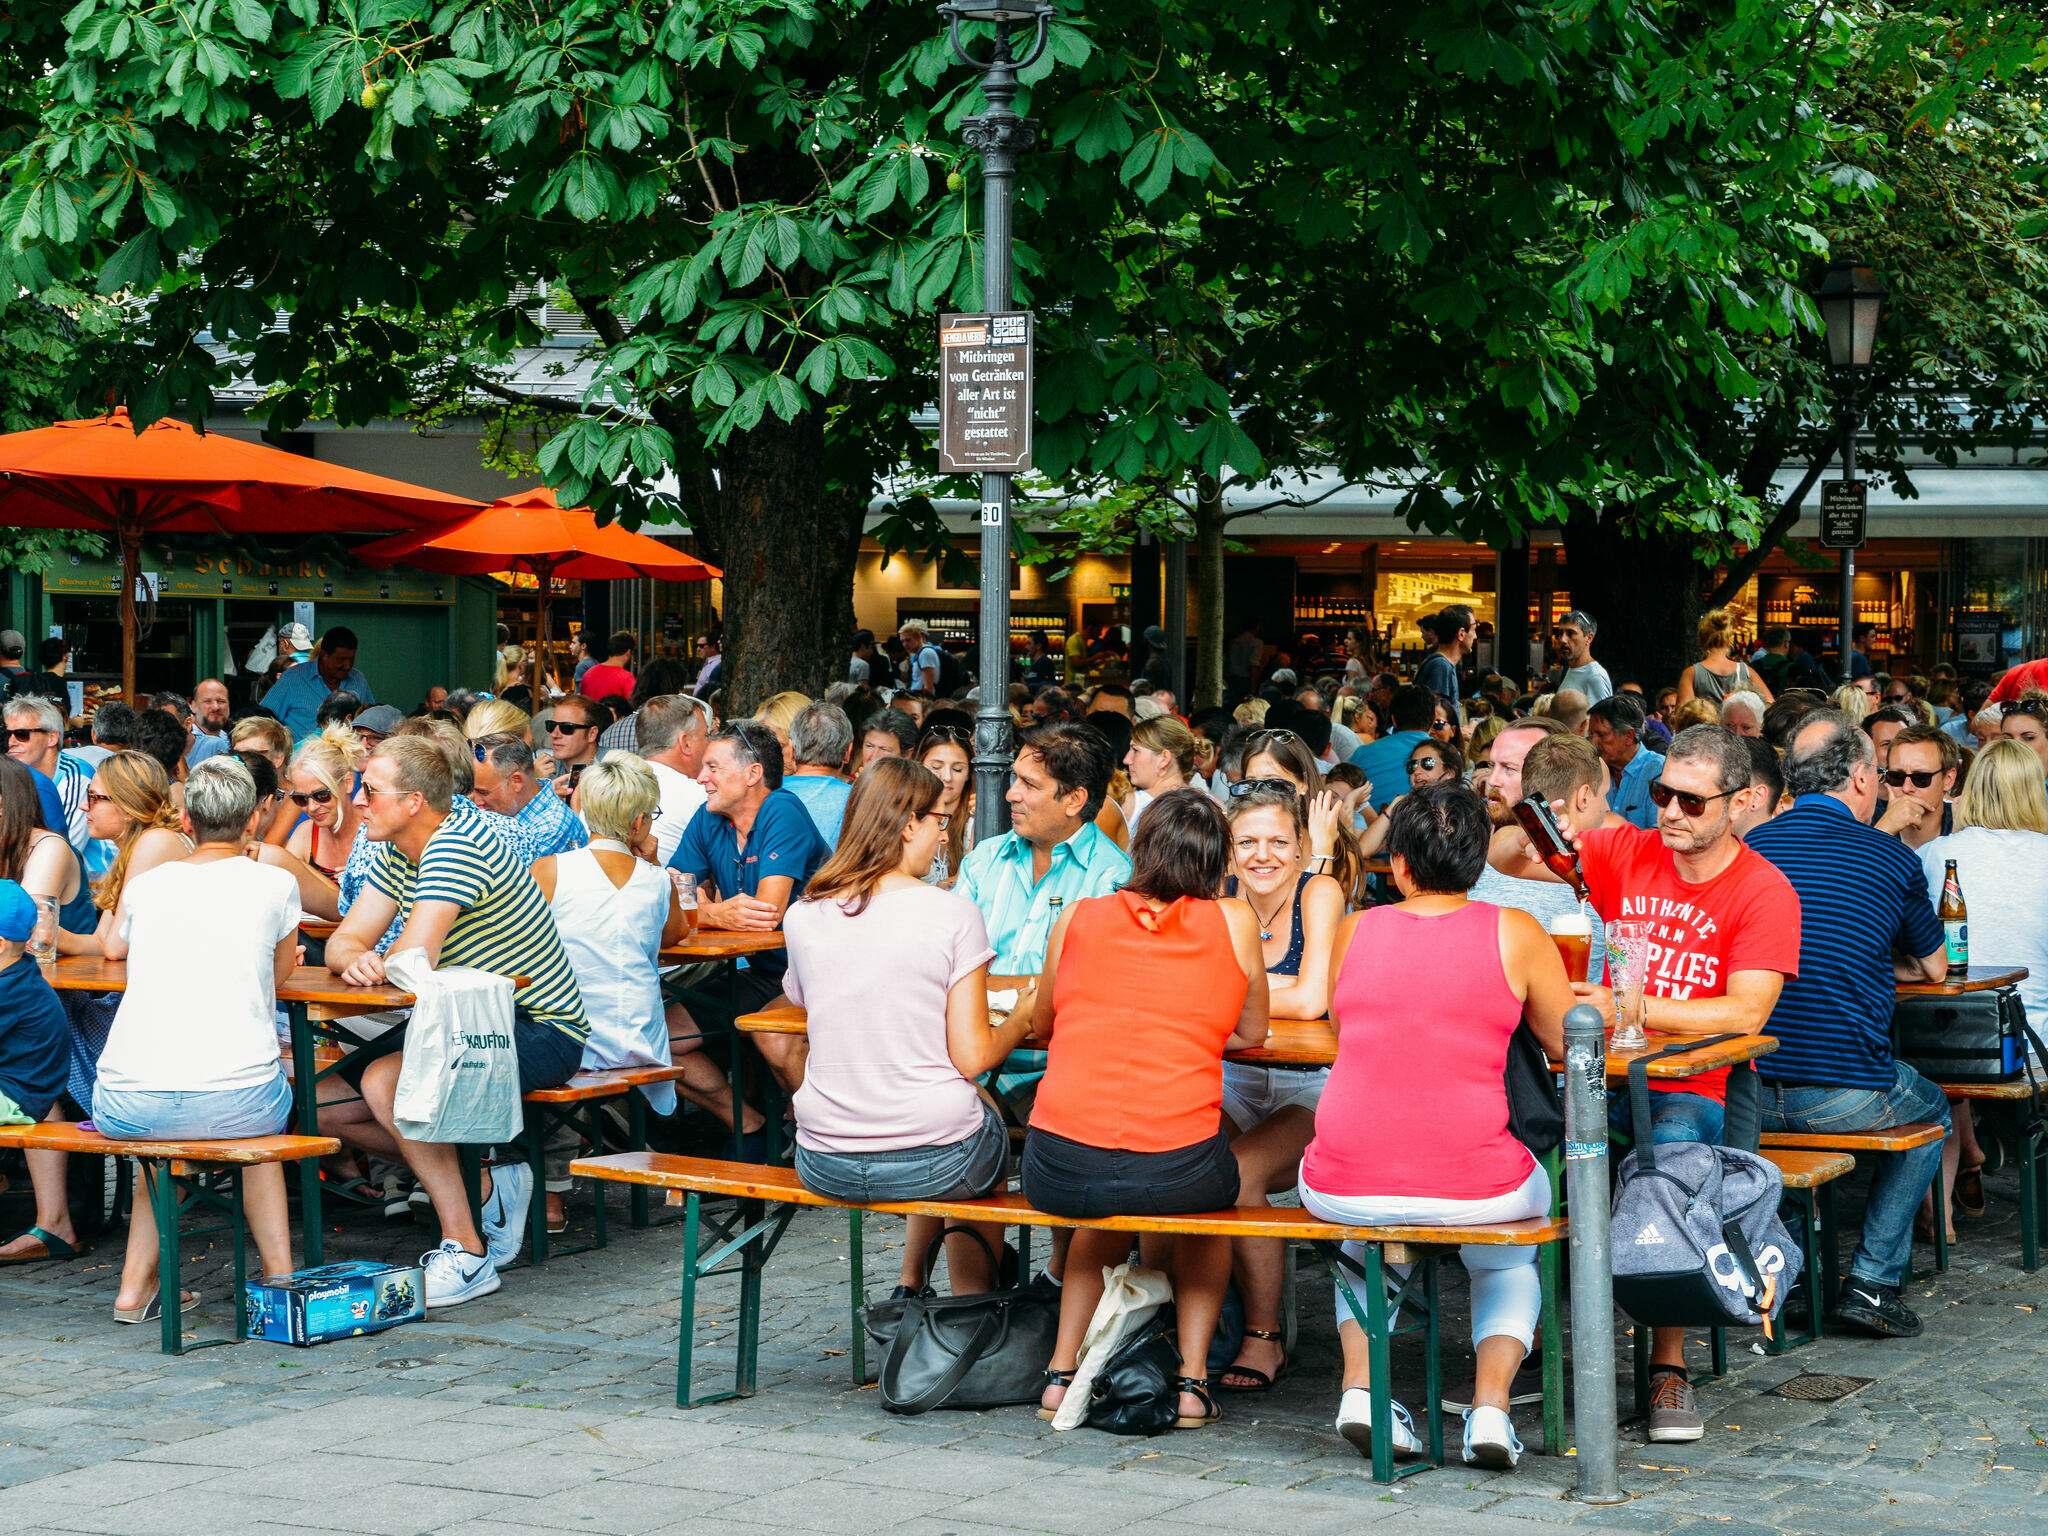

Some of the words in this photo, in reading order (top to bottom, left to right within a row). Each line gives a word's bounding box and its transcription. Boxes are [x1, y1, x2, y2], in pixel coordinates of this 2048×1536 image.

[959, 350, 1015, 364] Mitbringen
[949, 373, 968, 382] von
[972, 369, 1024, 381] Getränken
[957, 388, 980, 400] aller
[983, 387, 1000, 400] Art
[1003, 387, 1016, 399] ist
[964, 427, 1008, 440] gestattet
[1622, 896, 1717, 940] AUTHENTIC
[1634, 1237, 1665, 1246] adidas
[308, 1284, 350, 1303] playmobil
